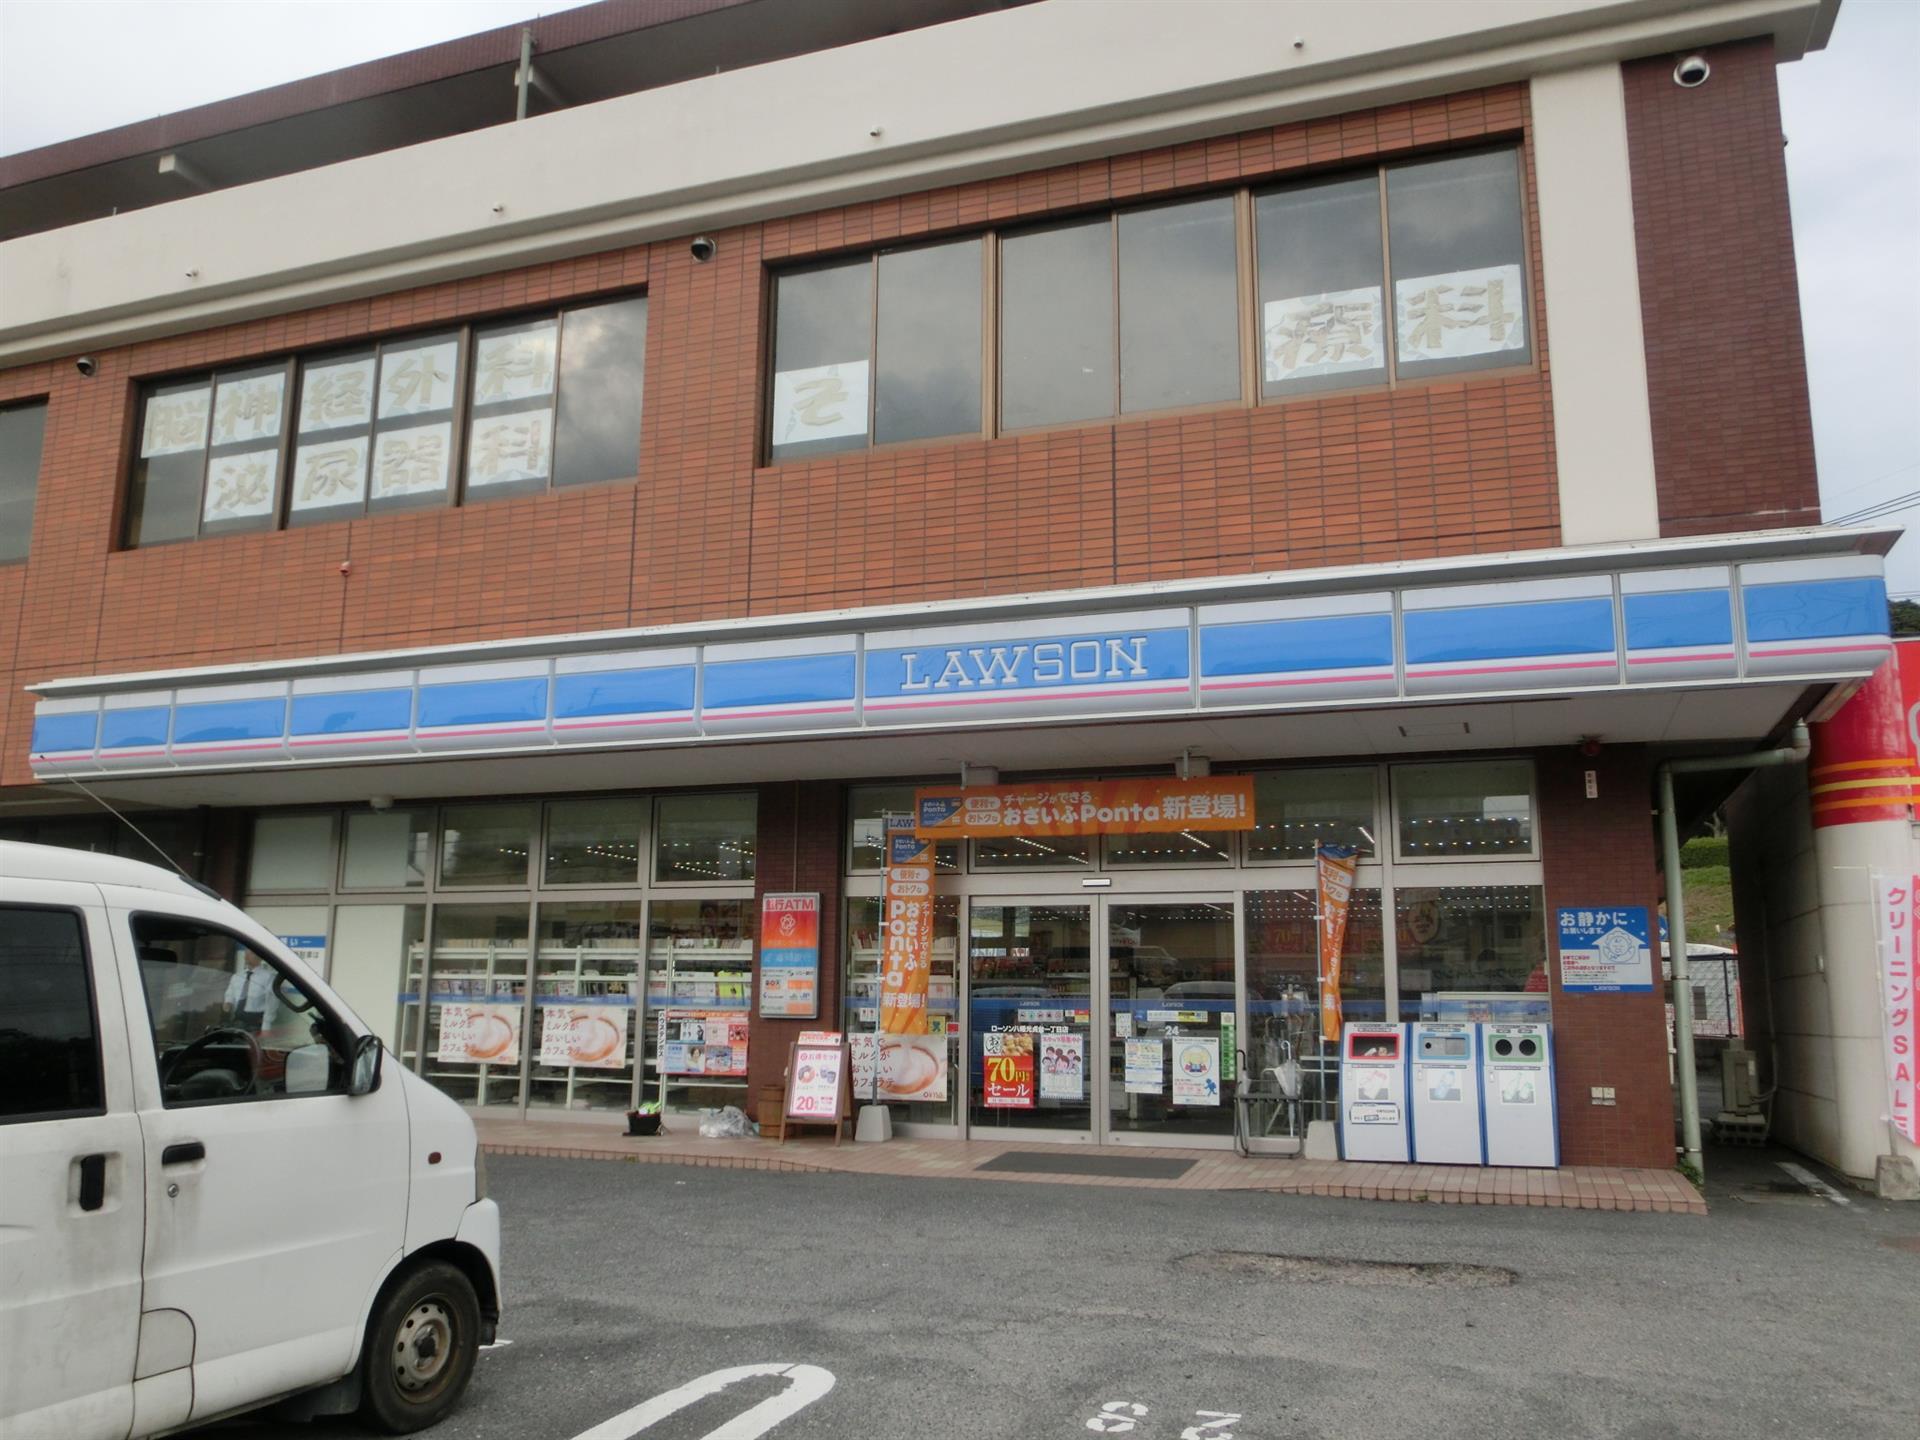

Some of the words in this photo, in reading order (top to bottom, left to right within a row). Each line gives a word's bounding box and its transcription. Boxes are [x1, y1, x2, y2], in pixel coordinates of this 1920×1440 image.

[148, 342, 549, 450] 脳神経外科
[212, 419, 543, 509] 泌尿器科
[901, 636, 1148, 690] LAWSON
[765, 896, 814, 911] 銀行ATM
[1559, 911, 1629, 927] お静かに
[658, 1012, 666, 1058] ハウステンボス
[1164, 1025, 1180, 1036] 24
[988, 1082, 1030, 1097] セール
[796, 1094, 814, 1112] 20
